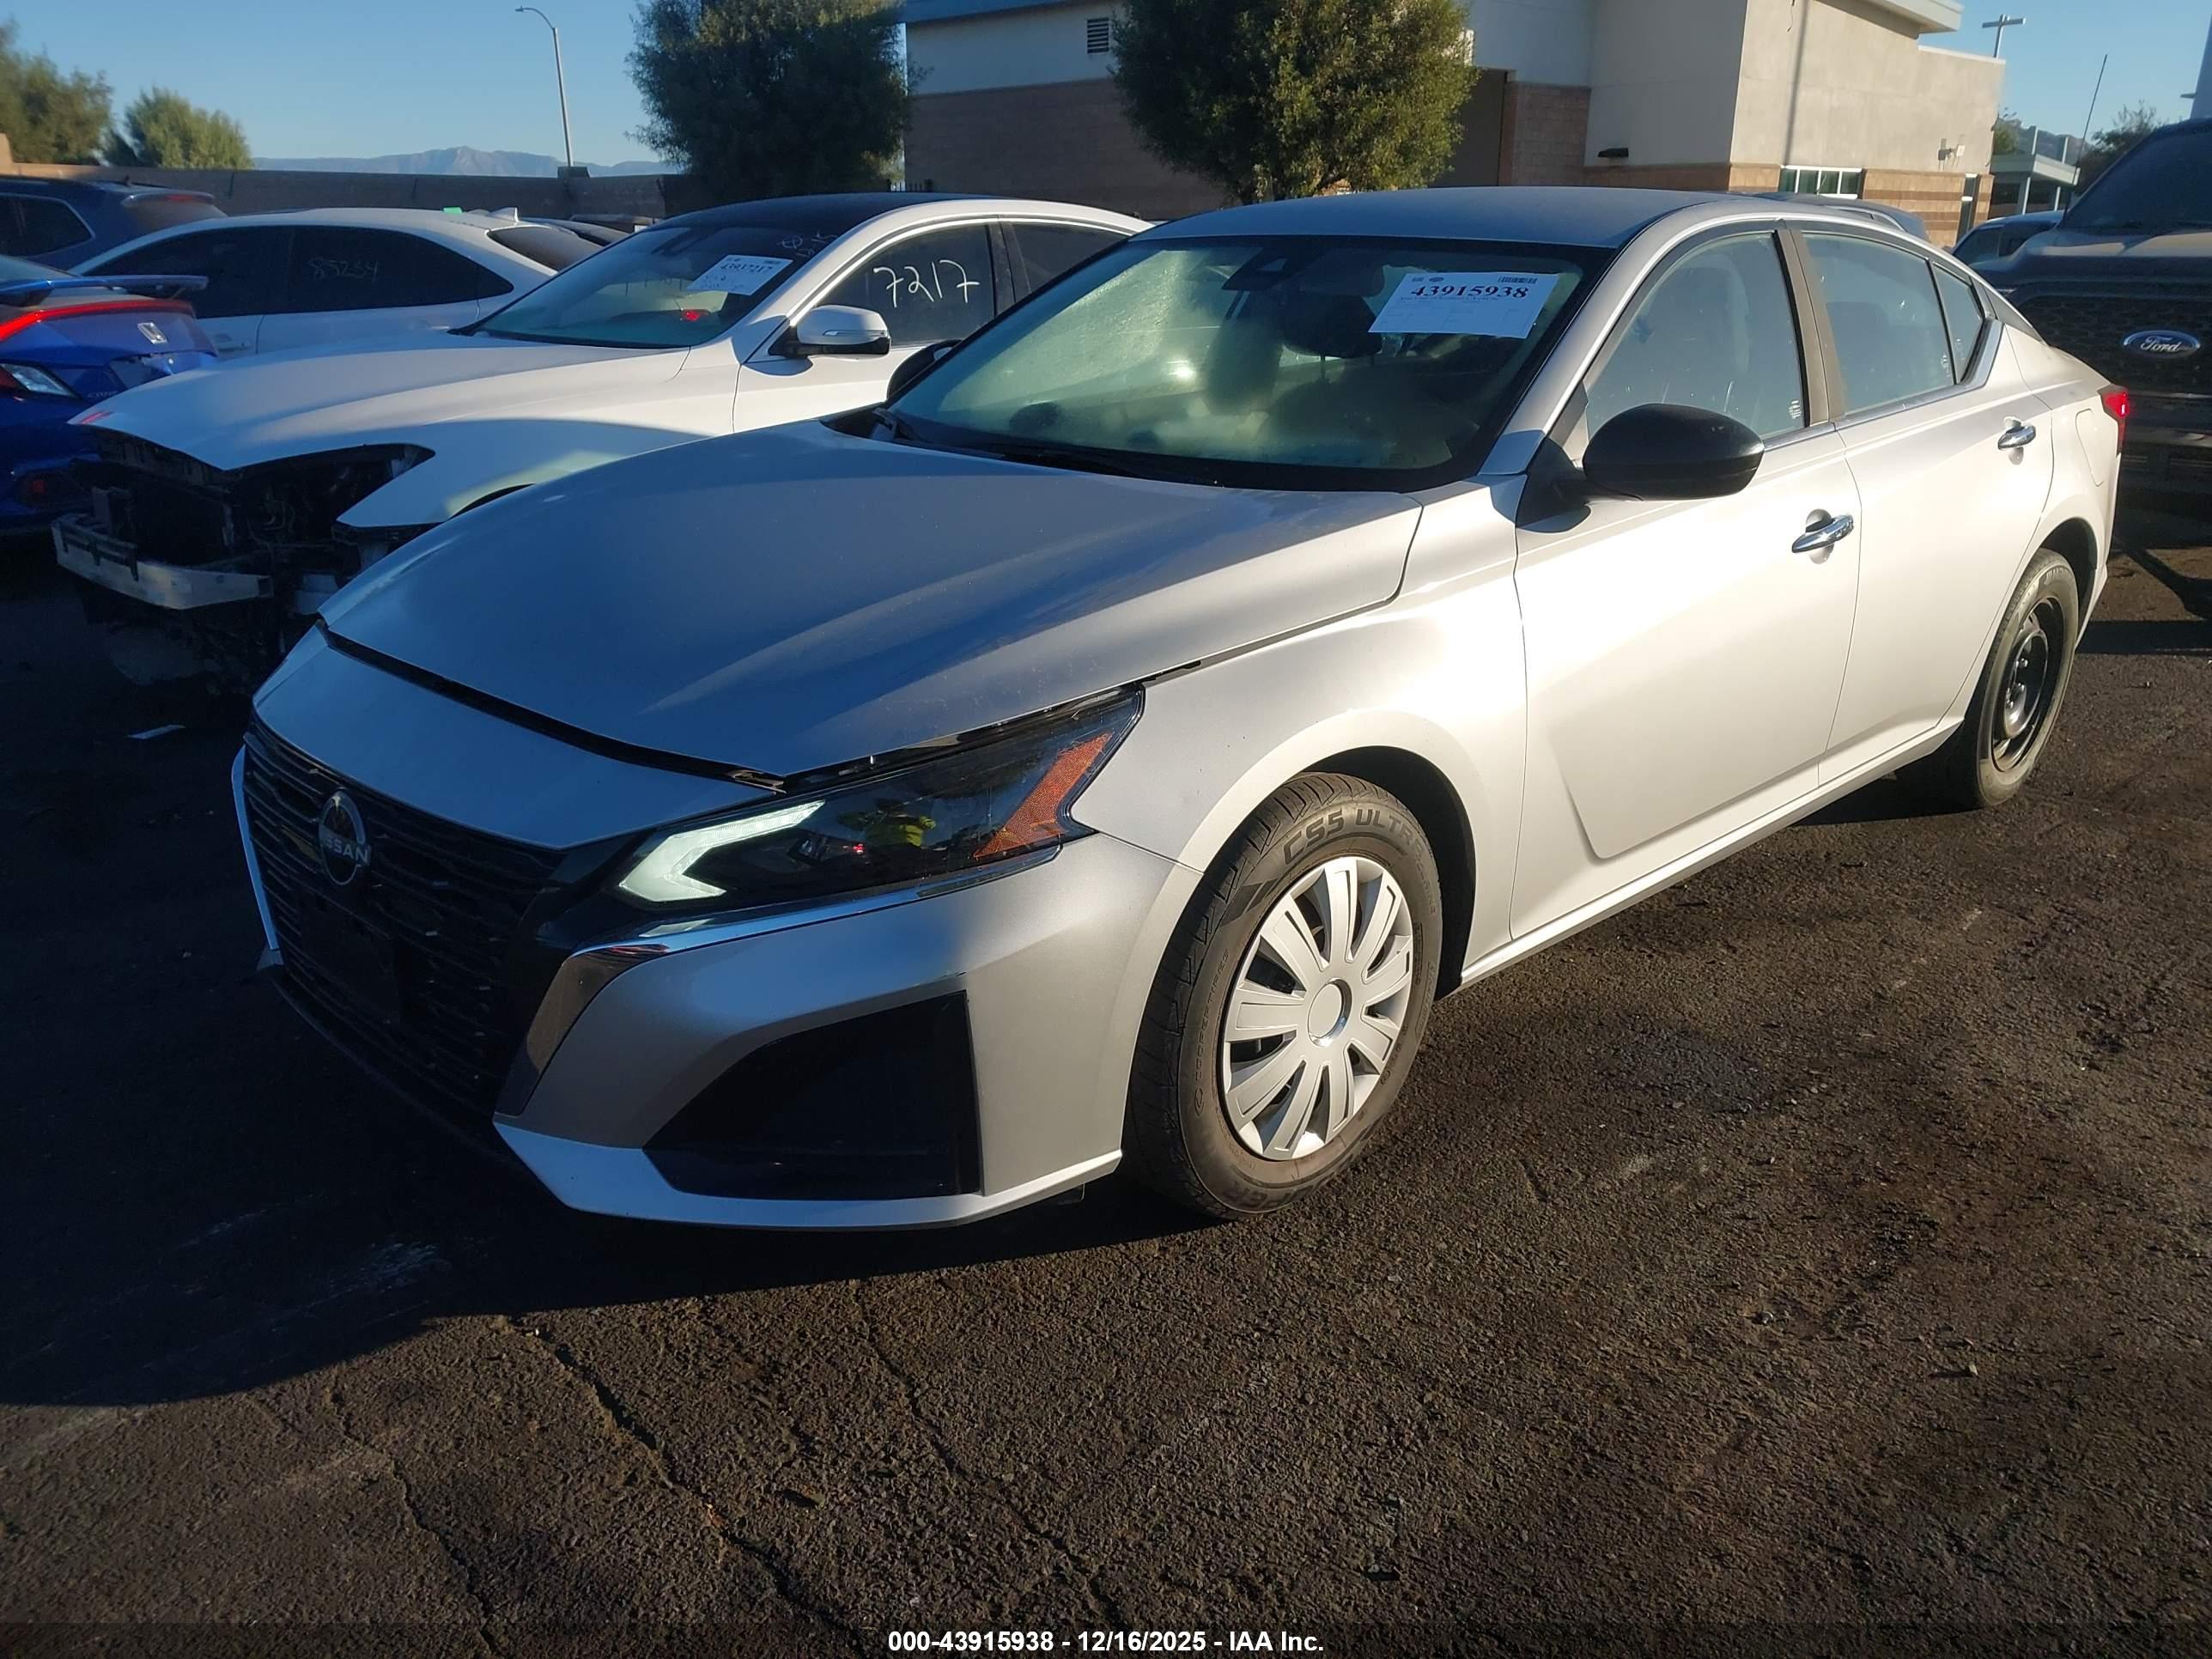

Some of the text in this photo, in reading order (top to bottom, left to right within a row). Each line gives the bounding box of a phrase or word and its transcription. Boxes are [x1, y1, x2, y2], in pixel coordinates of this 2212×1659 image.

[873, 258, 981, 308] 7217
[1411, 284, 1529, 298] 43915938
[2140, 335, 2185, 352] Ford
[320, 836, 370, 864] ISSAN
[1282, 808, 1346, 866] CS5
